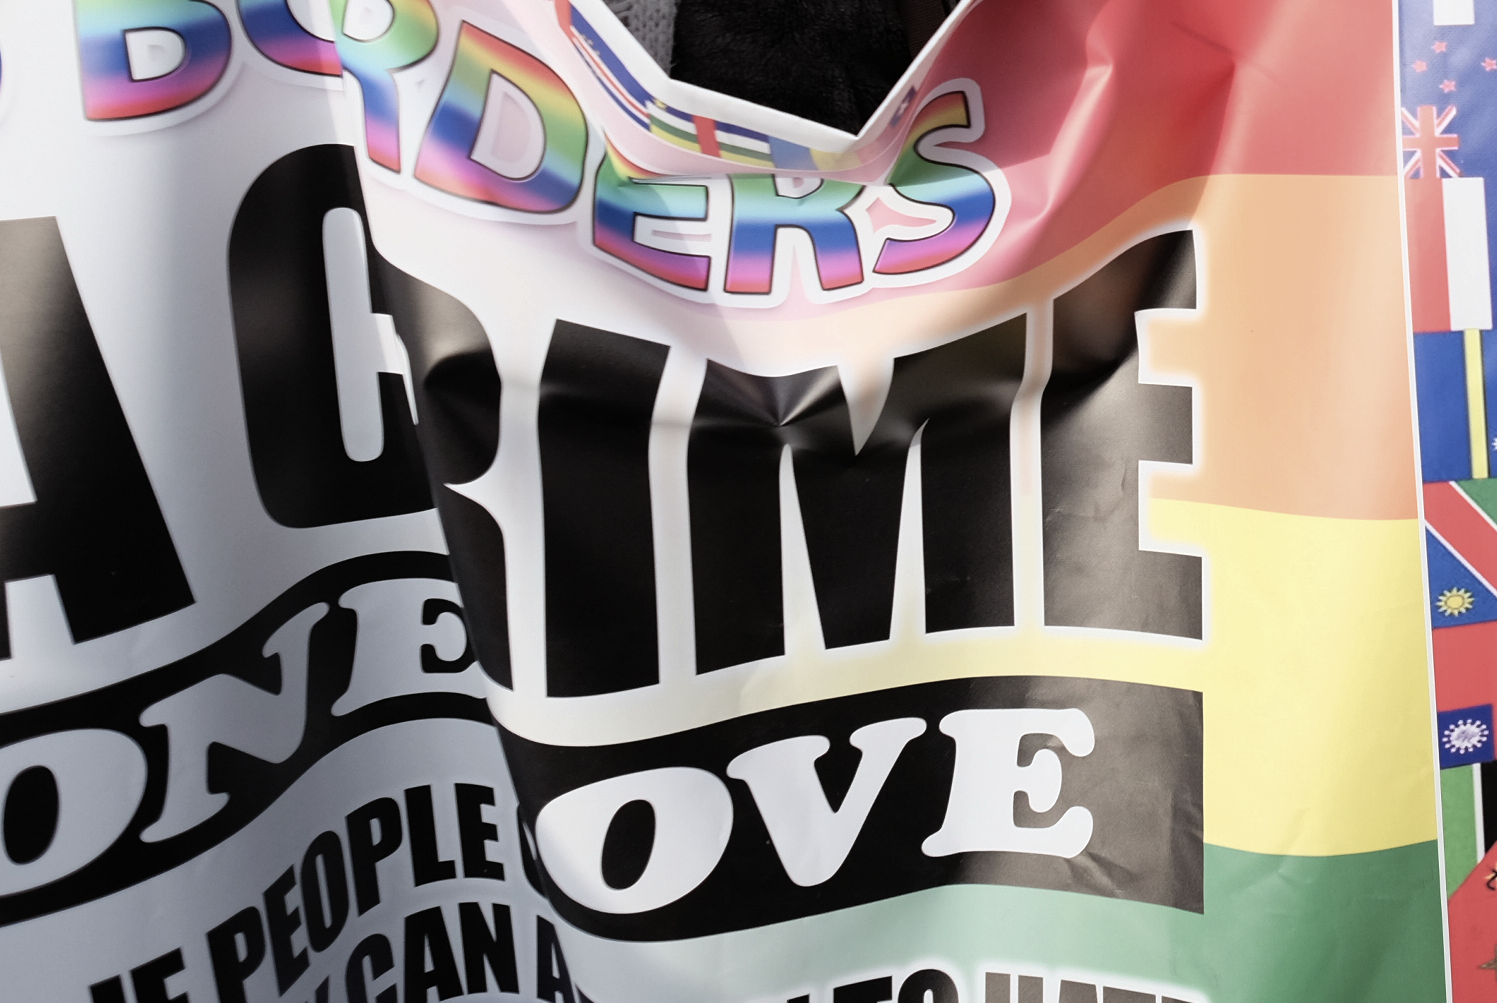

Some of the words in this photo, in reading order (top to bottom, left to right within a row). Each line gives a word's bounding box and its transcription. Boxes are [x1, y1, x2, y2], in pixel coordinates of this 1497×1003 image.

[206, 782, 505, 1003] PEOPLE
[534, 707, 1095, 914] OVE
[345, 902, 519, 1003] CAN
